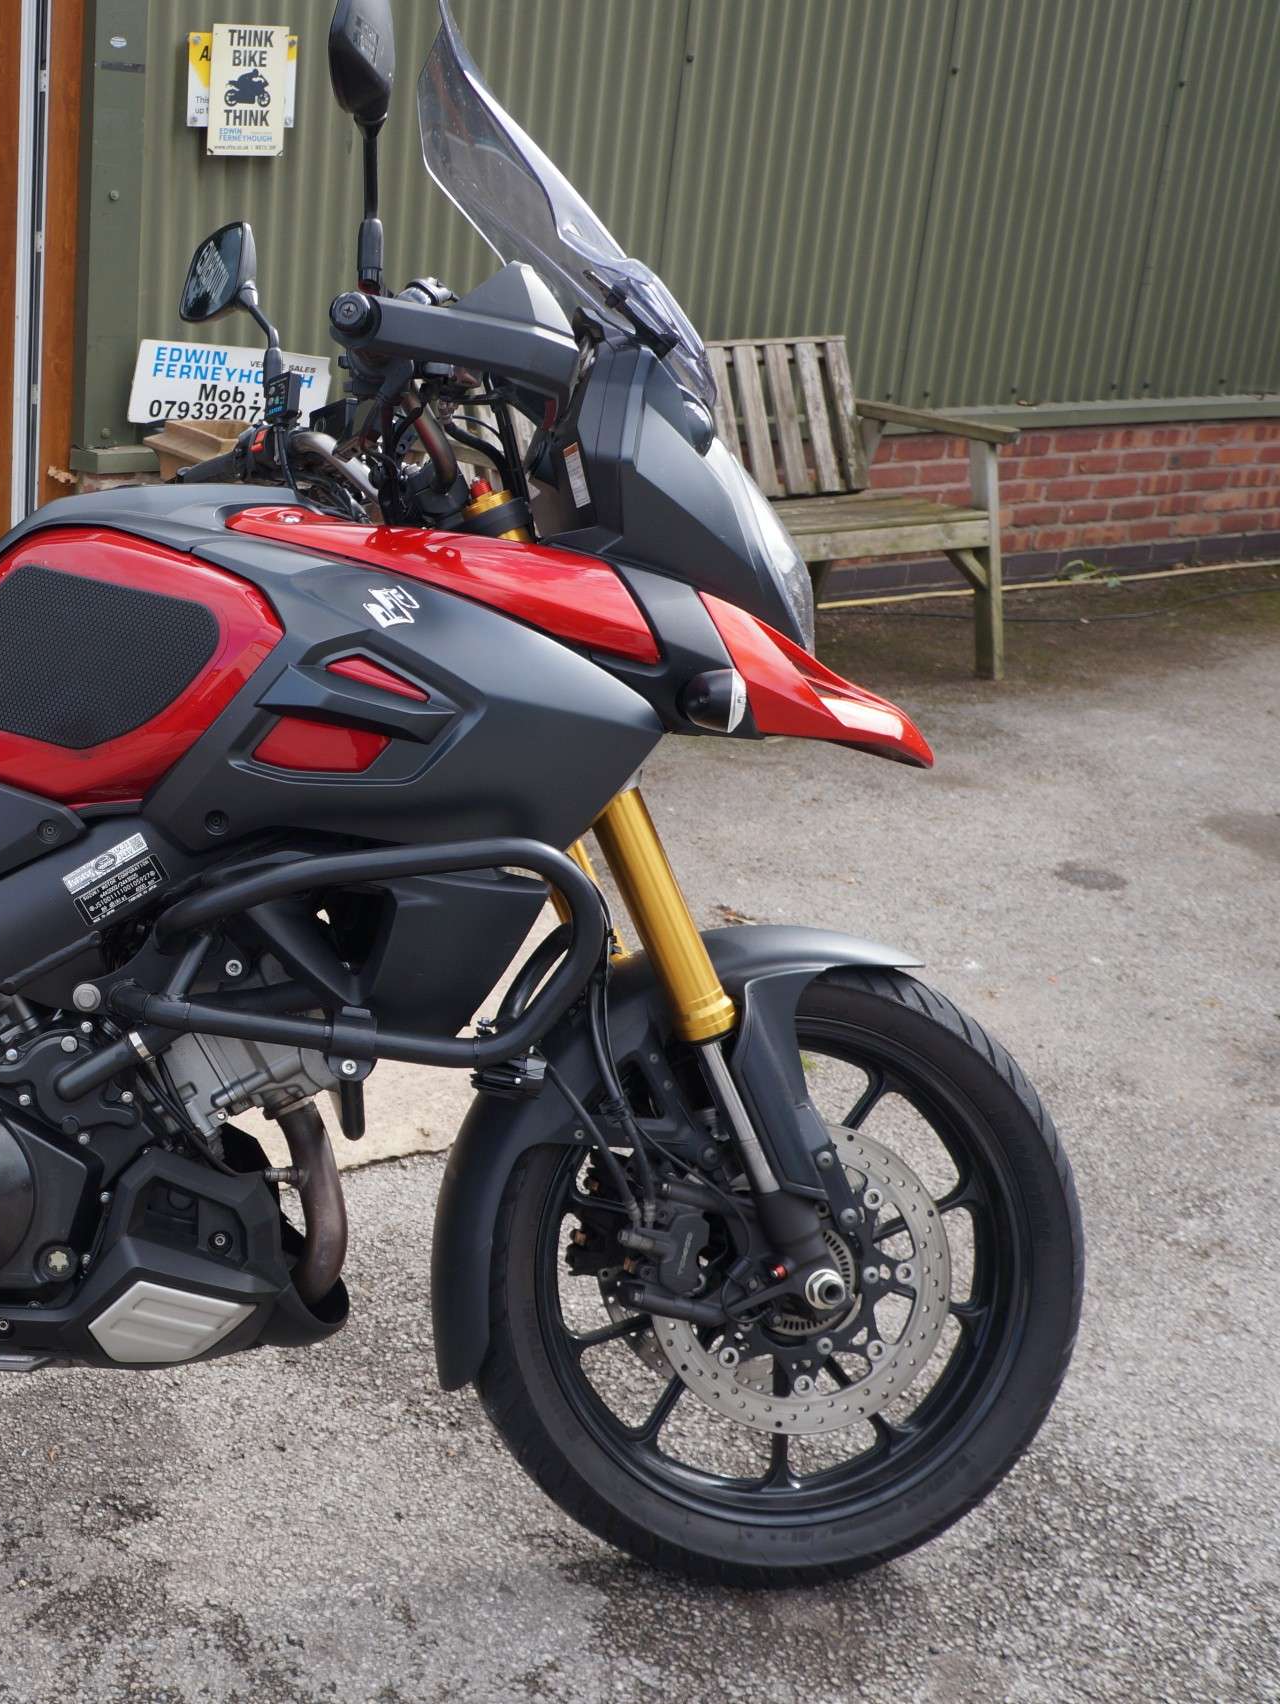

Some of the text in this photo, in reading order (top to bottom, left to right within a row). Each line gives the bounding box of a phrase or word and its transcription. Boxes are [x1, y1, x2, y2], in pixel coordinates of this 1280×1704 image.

[228, 29, 274, 48] THINK
[232, 50, 267, 68] BIKE
[223, 109, 270, 127] THINK
[155, 346, 228, 366] EDWIN
[152, 362, 314, 388] FERNEYHOH
[289, 364, 317, 374] SALES
[198, 383, 246, 404] Mob
[149, 399, 263, 423] 07939207
